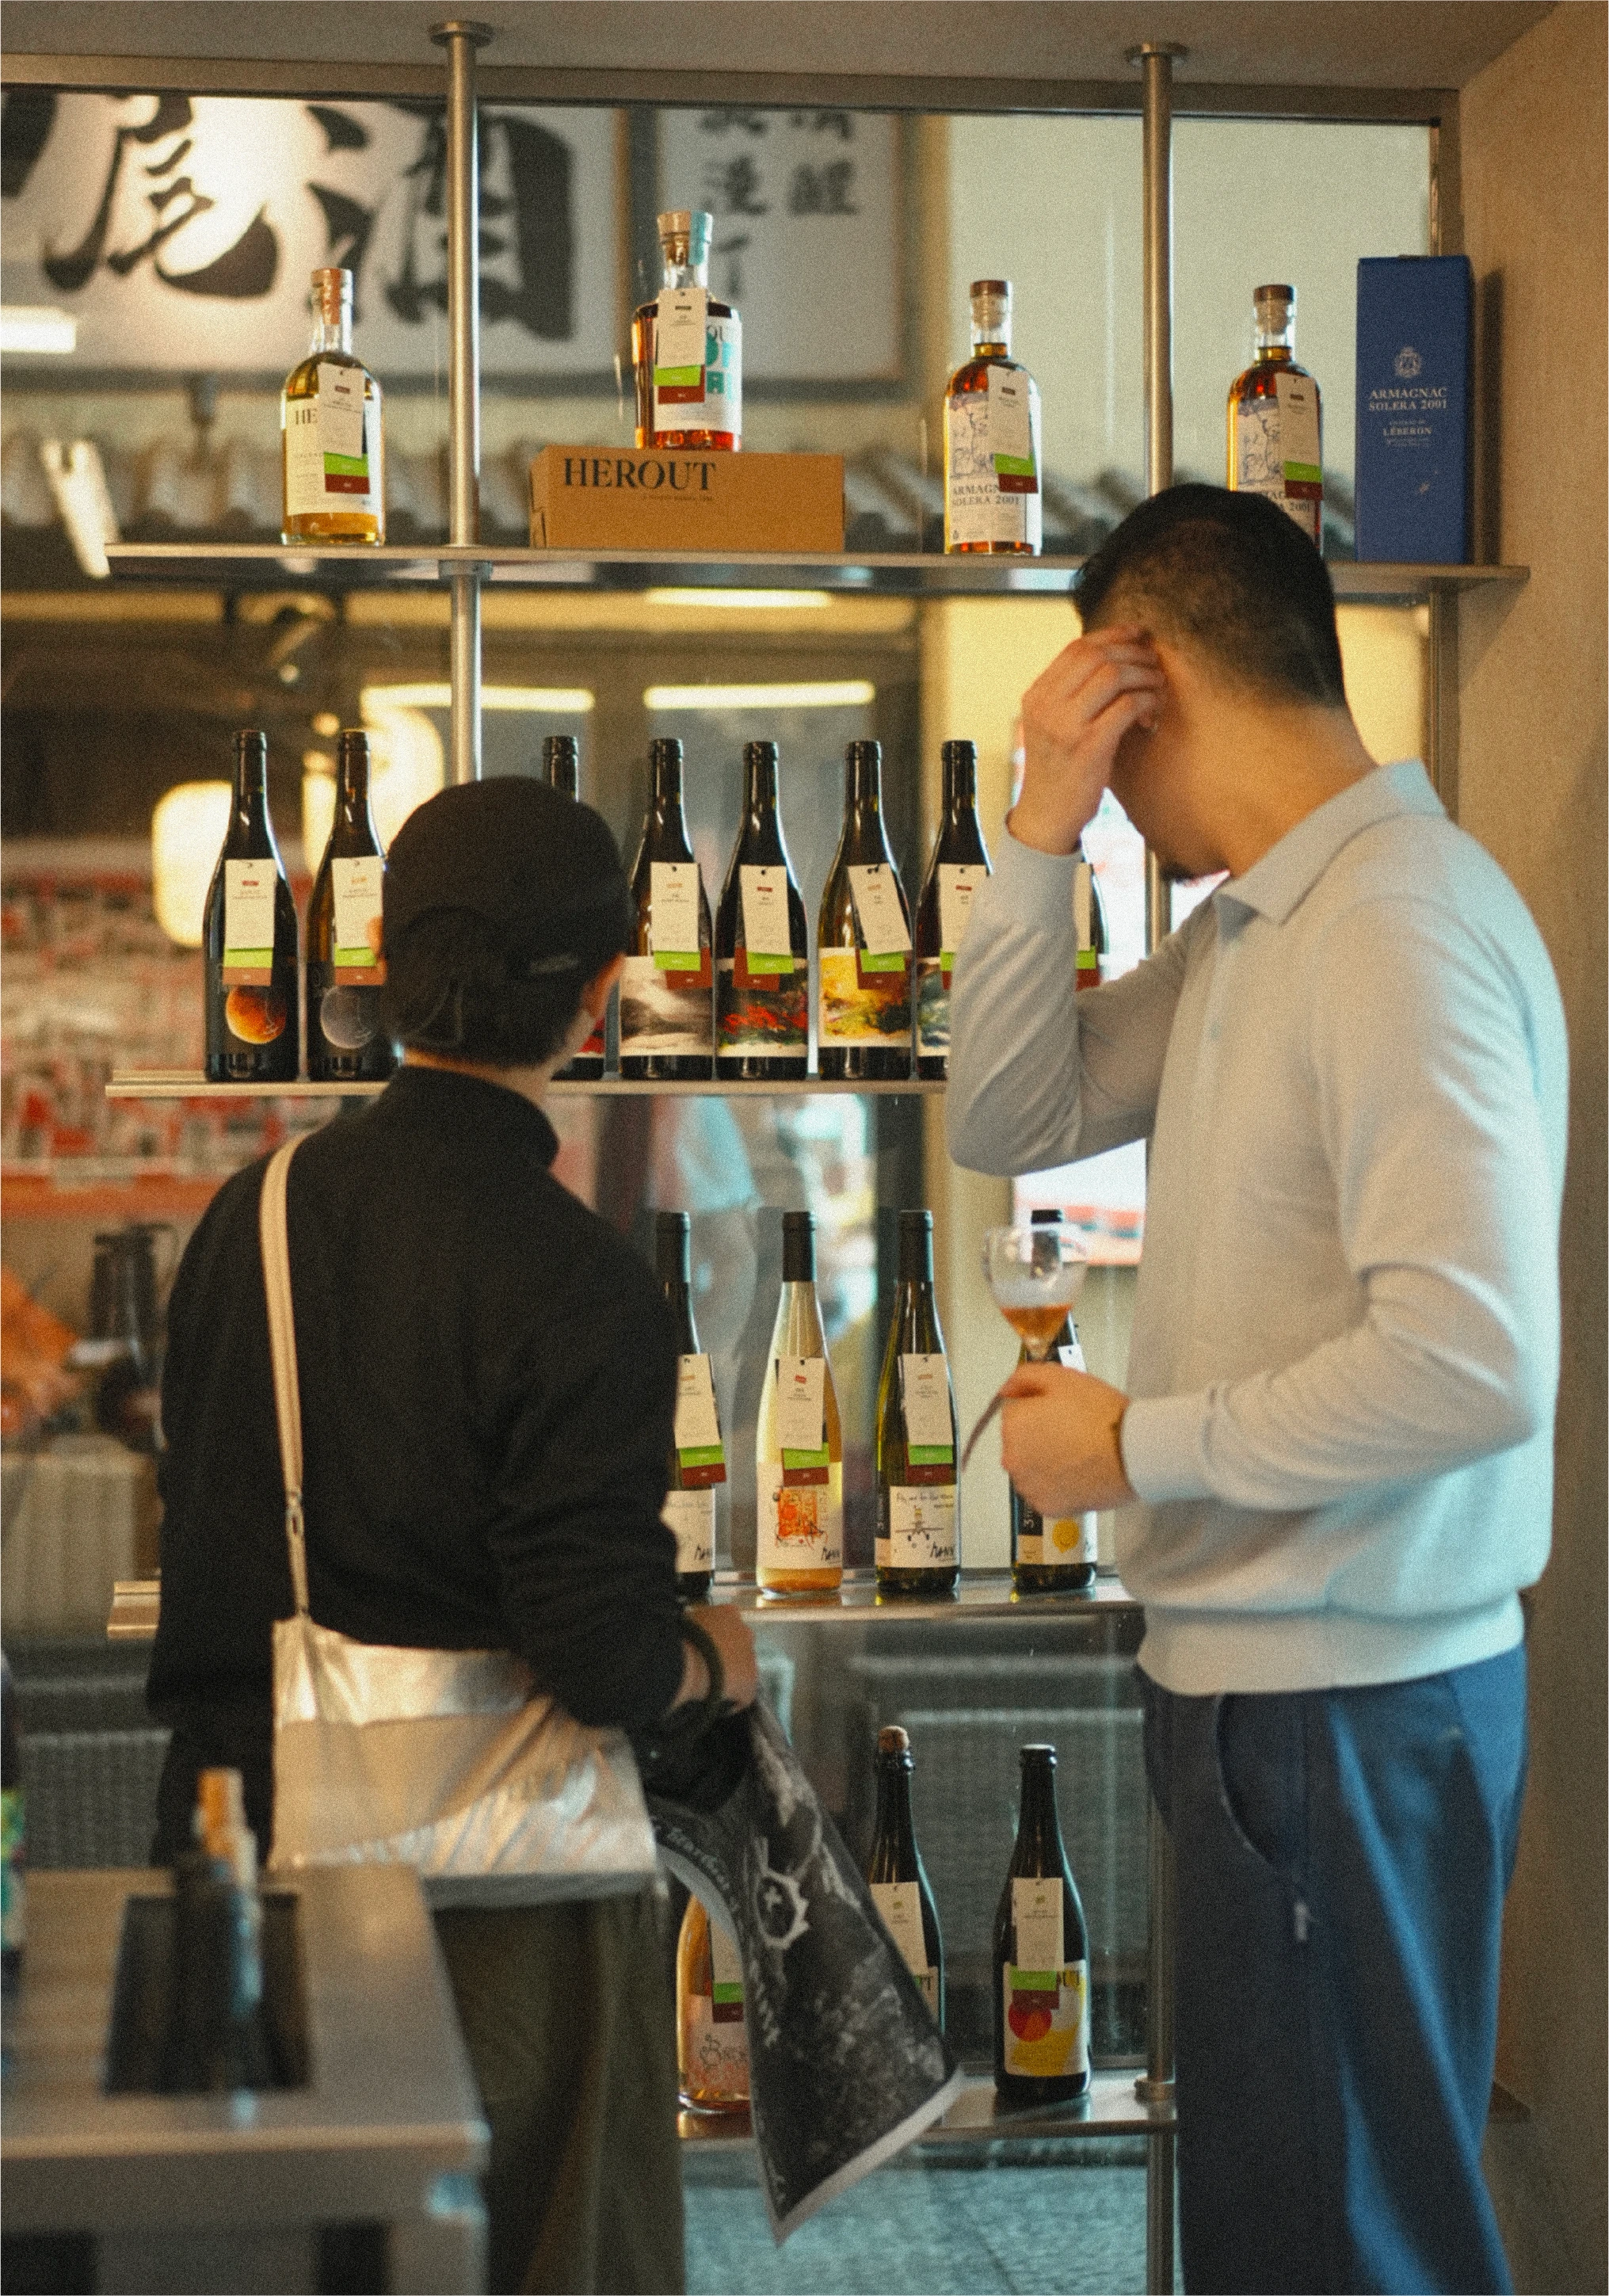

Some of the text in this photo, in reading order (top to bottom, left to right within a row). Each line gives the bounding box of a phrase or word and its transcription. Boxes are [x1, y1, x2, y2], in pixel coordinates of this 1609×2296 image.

[1370, 387, 1447, 399] ARMAGNAC
[1368, 399, 1447, 410] SOLERA 2001
[564, 458, 716, 490] HEROUT
[953, 484, 999, 494] ARMAGN
